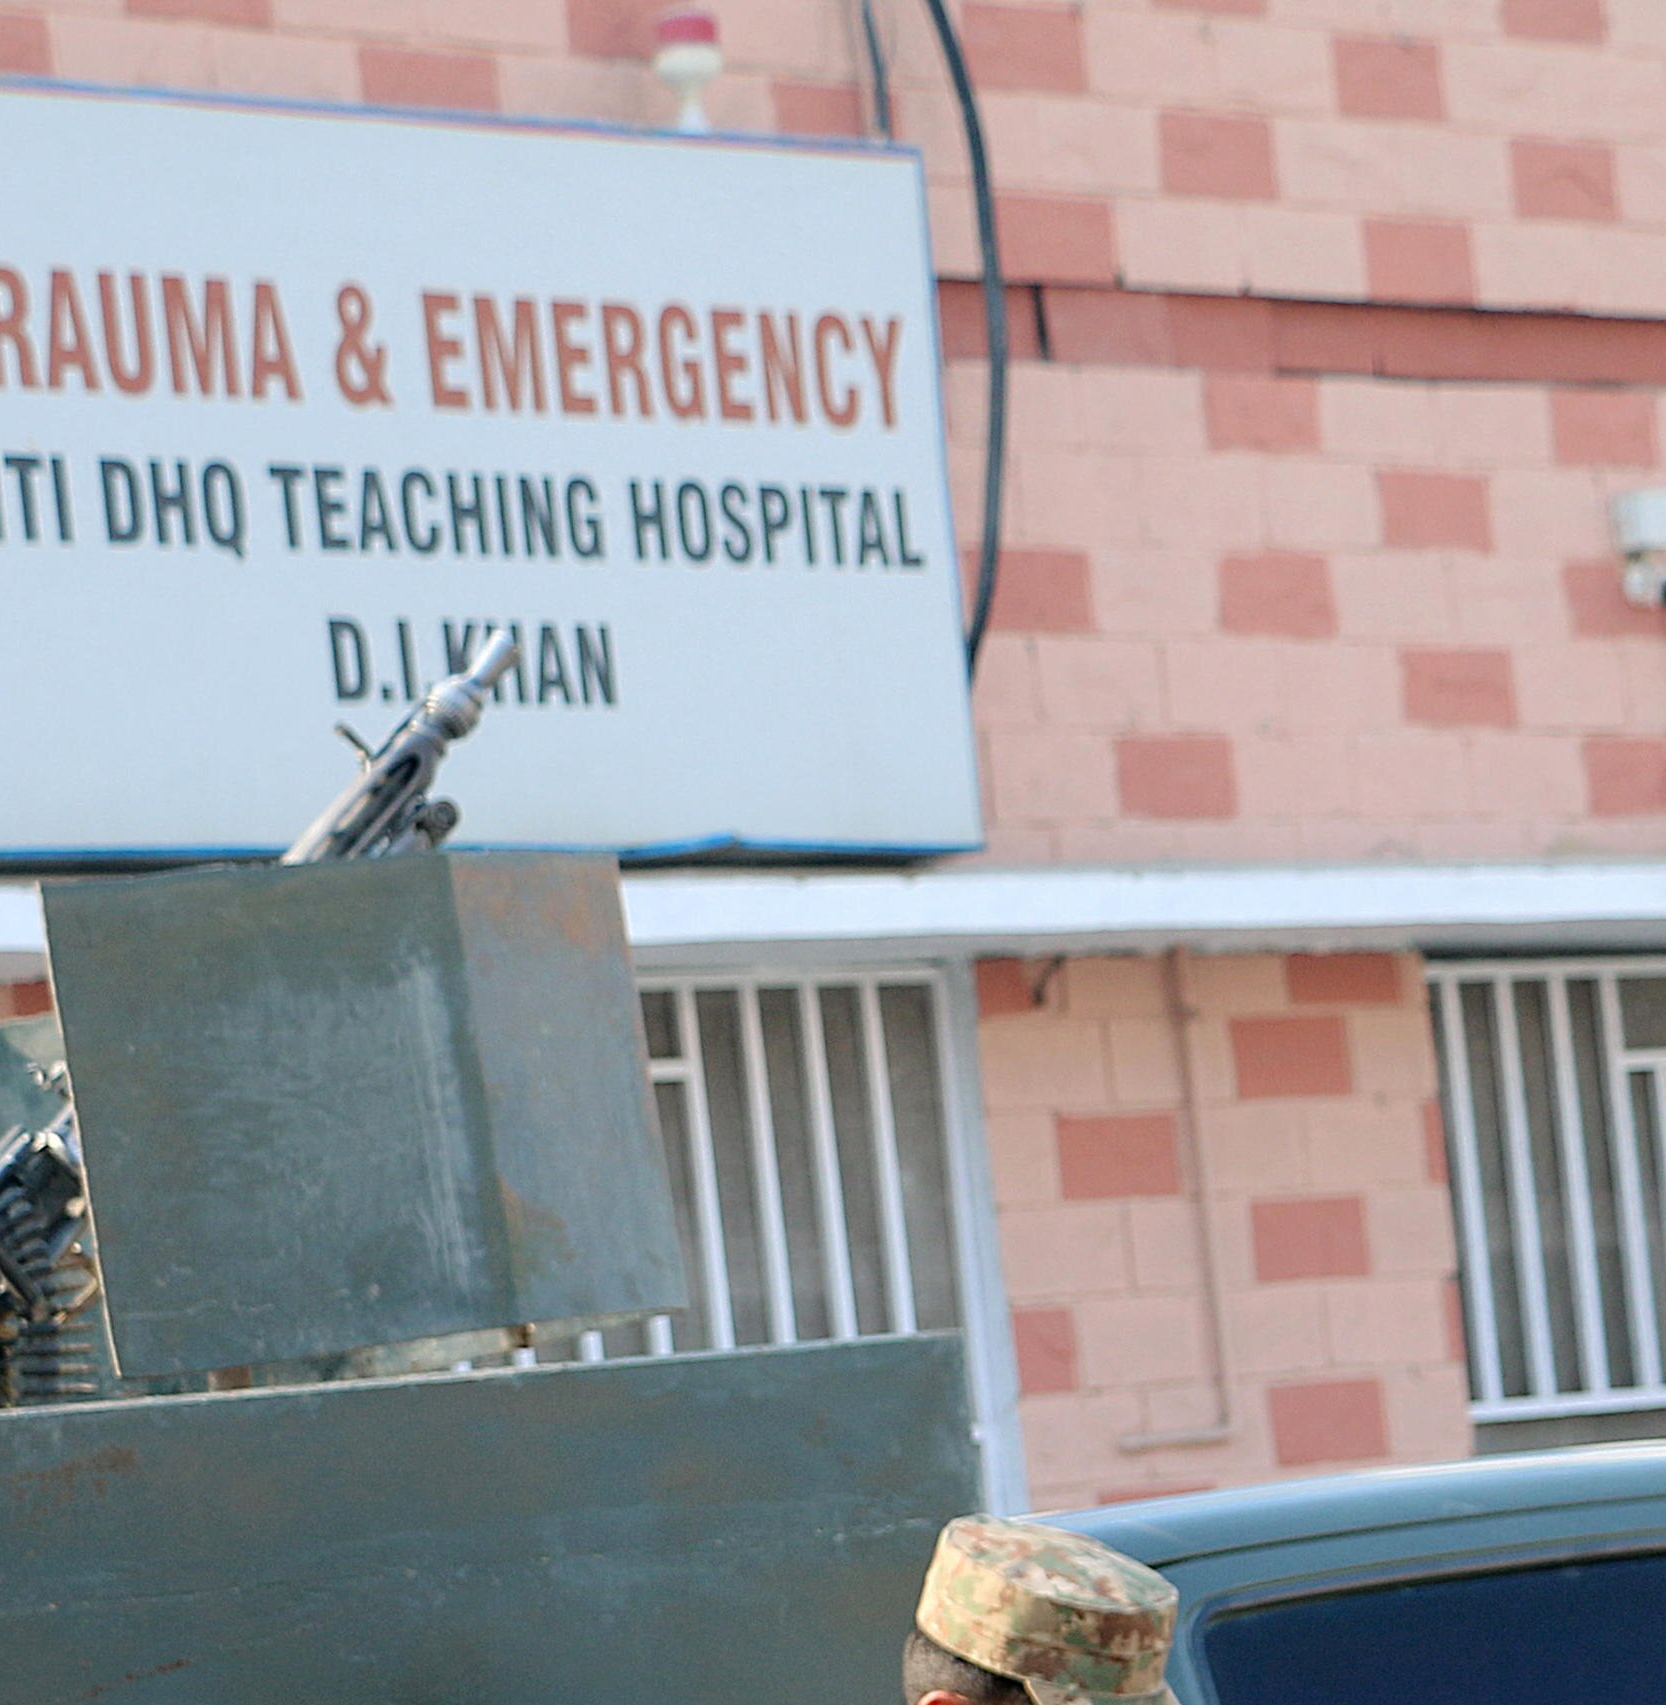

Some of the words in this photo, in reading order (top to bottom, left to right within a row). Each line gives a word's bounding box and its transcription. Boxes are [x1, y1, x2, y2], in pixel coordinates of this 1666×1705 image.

[336, 285, 393, 406] &
[420, 291, 904, 430] EMERGENCY
[99, 456, 248, 561] DHQ
[268, 464, 606, 560] TEACHING
[629, 477, 925, 569] HOSPITAL
